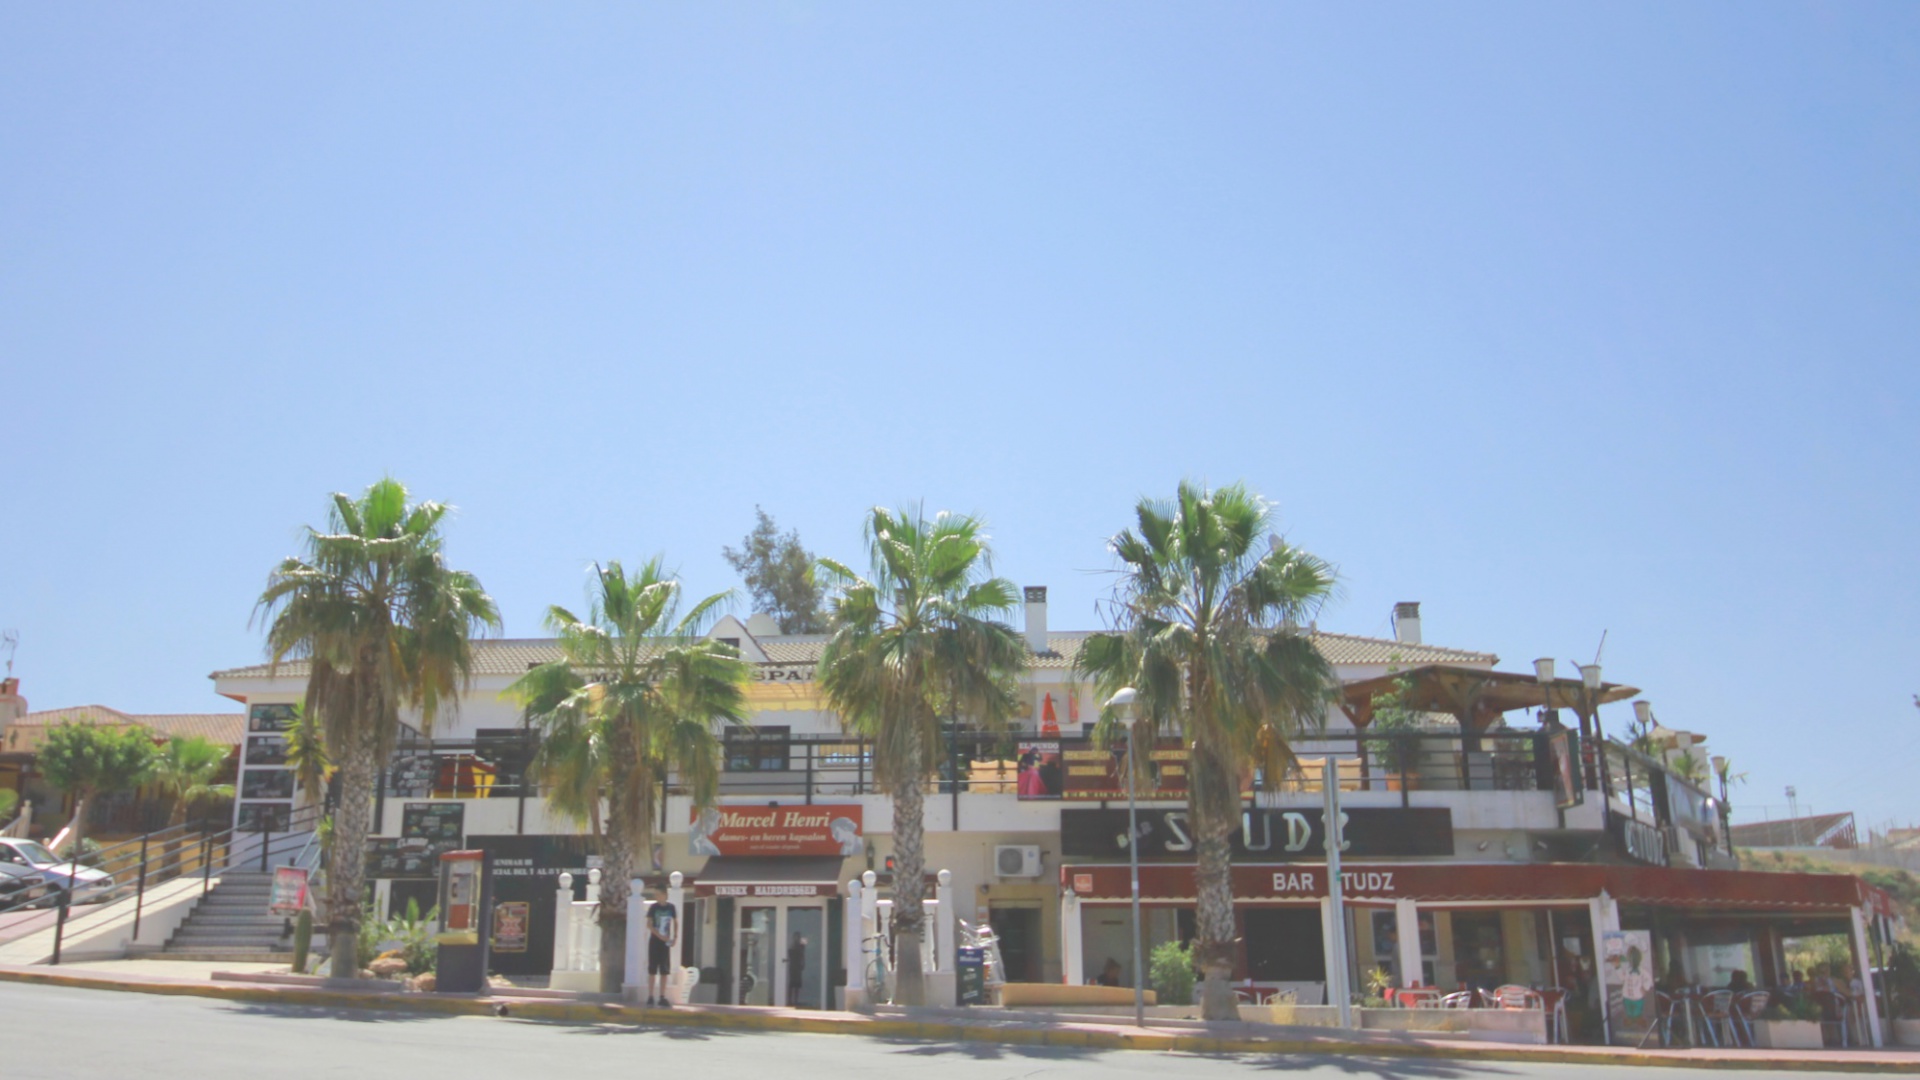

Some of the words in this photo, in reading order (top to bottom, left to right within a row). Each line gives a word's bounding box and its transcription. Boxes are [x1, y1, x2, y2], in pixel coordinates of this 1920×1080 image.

[719, 811, 776, 828] Marcel
[783, 811, 831, 828] Henri
[762, 833, 786, 842] heren
[789, 833, 827, 843] kapsalon
[1272, 872, 1314, 891] BAR
[1341, 872, 1395, 891] TUDZ
[715, 885, 748, 896] UNISEX
[754, 885, 817, 896] HAIRDRESSER
